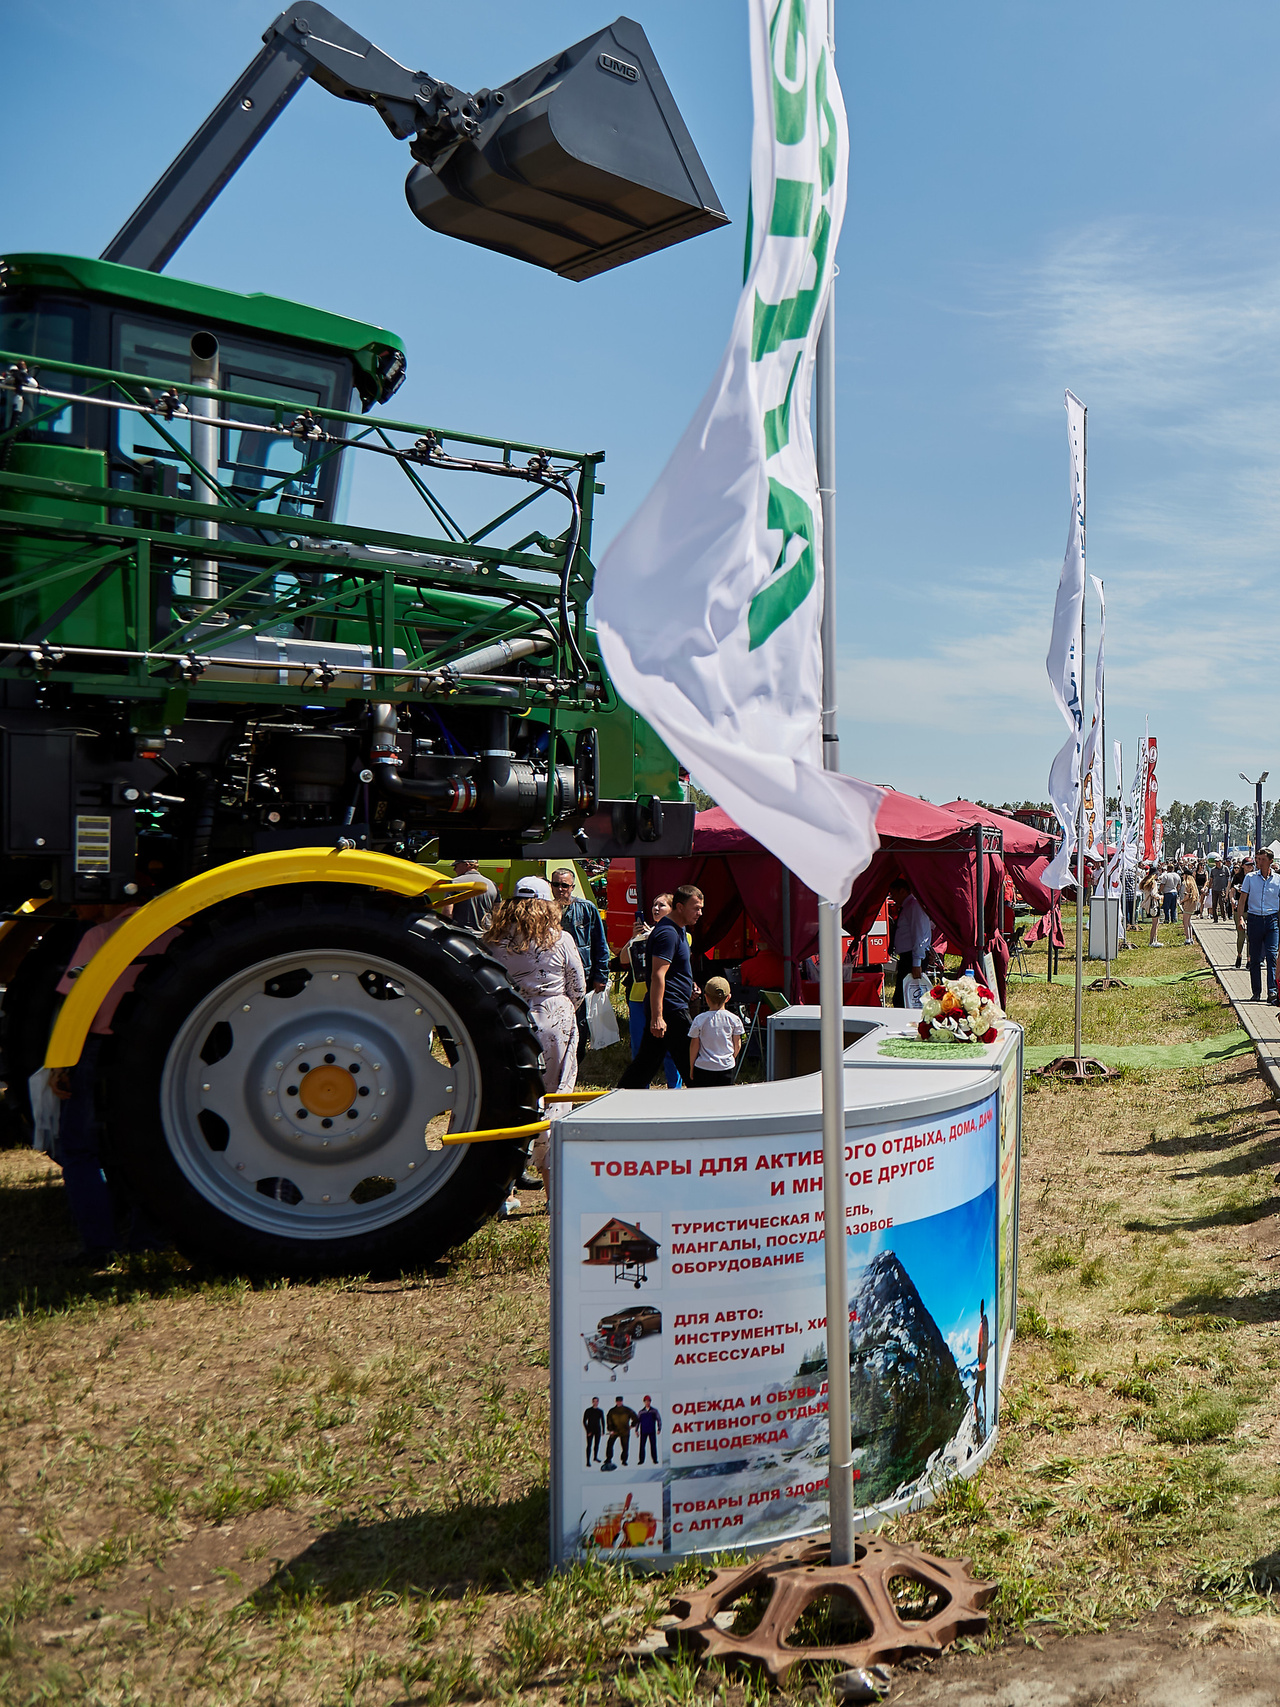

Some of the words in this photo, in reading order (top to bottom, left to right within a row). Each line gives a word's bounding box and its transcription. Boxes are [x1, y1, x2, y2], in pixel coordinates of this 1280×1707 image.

[603, 56, 636, 79] UMG
[870, 938, 883, 946] 150
[591, 1160, 692, 1177] ТОВАРЫ
[699, 1156, 748, 1177] ДЛЯ
[754, 1143, 877, 1171] АКТИВОГО
[882, 1129, 946, 1154] ОТДЫХА,
[949, 1119, 978, 1141] ДОМА,
[978, 1108, 993, 1131] ДАЧИ
[771, 1181, 785, 1197] И
[792, 1170, 873, 1195] МНОЕ
[877, 1156, 935, 1184] ДРУГОЕ
[672, 1213, 810, 1235] ТУРИСТИЧЕСКАЯ
[814, 1204, 873, 1223] МЕЛЬ,
[672, 1238, 762, 1255] МАНГАЛЫ,
[845, 1218, 894, 1236] АЗОВОЕ
[672, 1252, 804, 1274] ОБОРУДОВАНИЕ
[673, 1313, 709, 1328] ДЛЯ
[714, 1308, 763, 1323] АВТО:
[674, 1322, 803, 1346] ИНСТРУМЕНТЫ,
[807, 1310, 861, 1331] ХИЯ,
[673, 1343, 785, 1366] АКСЕССУАРЫ
[671, 1397, 745, 1416] ОДЕЖДА
[750, 1395, 761, 1407] И
[766, 1386, 817, 1404] ОБУВЬ
[671, 1412, 772, 1434] АКТИВНОГО
[776, 1401, 830, 1421] ОТДЫХ
[672, 1428, 789, 1454] СПЕЦОДЕЖДА
[673, 1495, 743, 1514] ТОВАРЫ
[747, 1488, 780, 1506] ДЛЯ
[785, 1469, 861, 1498] ЗДОРЯ
[673, 1522, 684, 1533] С
[689, 1514, 744, 1532] АЛТАЯ
